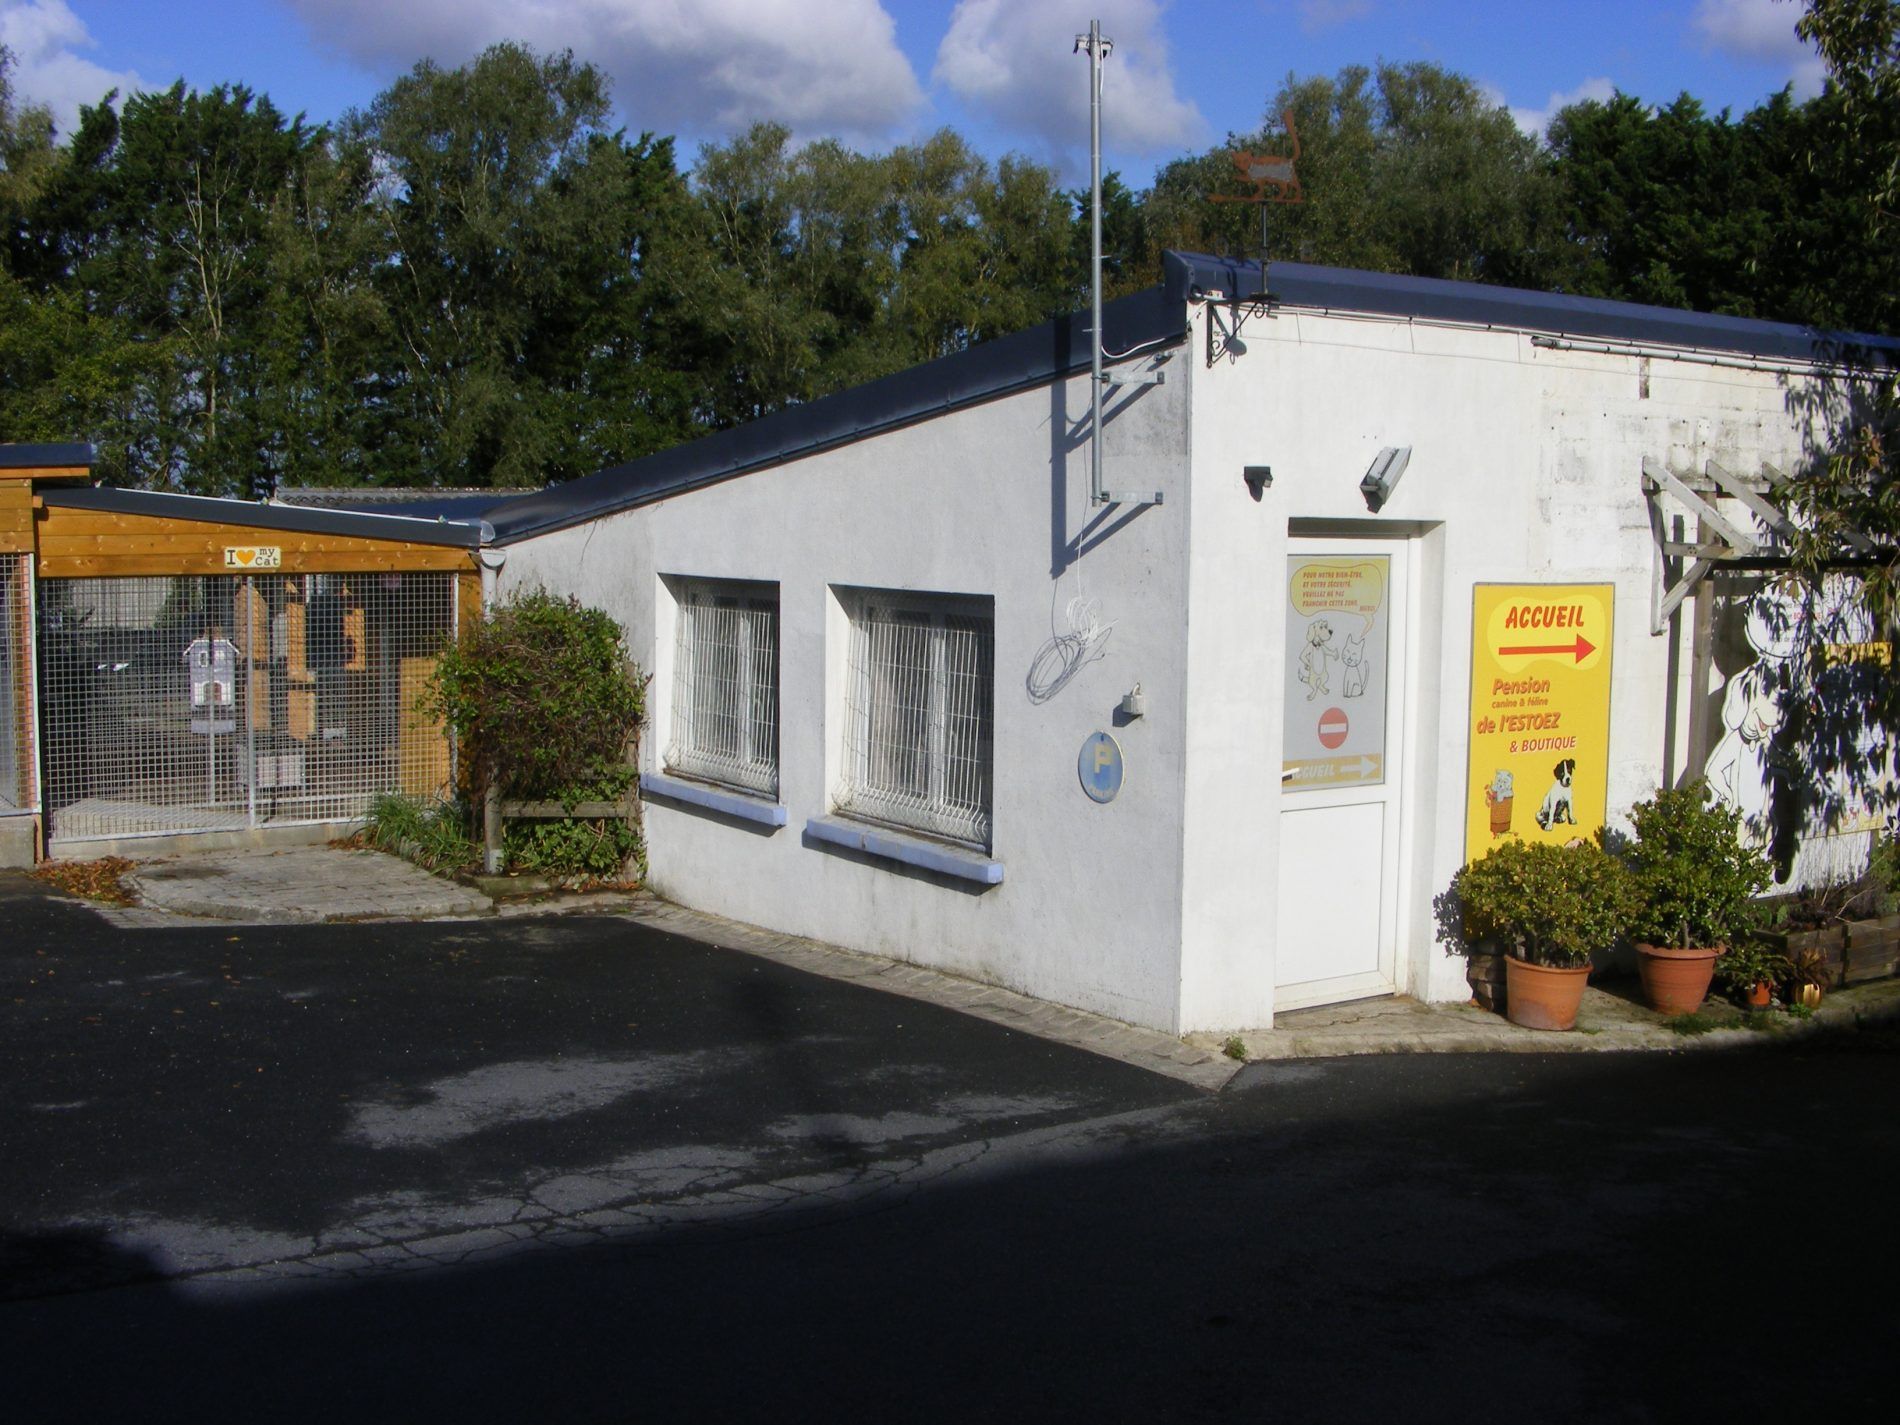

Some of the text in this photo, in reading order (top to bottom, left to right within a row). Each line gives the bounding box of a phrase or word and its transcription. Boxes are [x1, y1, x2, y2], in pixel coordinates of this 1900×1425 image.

[227, 548, 275, 565] I my
[255, 557, 279, 566] Cat
[1505, 605, 1585, 629] ACCUEIL
[1493, 676, 1551, 695] Pension
[1492, 697, 1549, 709] canine & féline
[1477, 711, 1561, 734] de l'ESTOEZ
[1509, 736, 1577, 753] & BOUTIQUE
[1094, 743, 1113, 773] P
